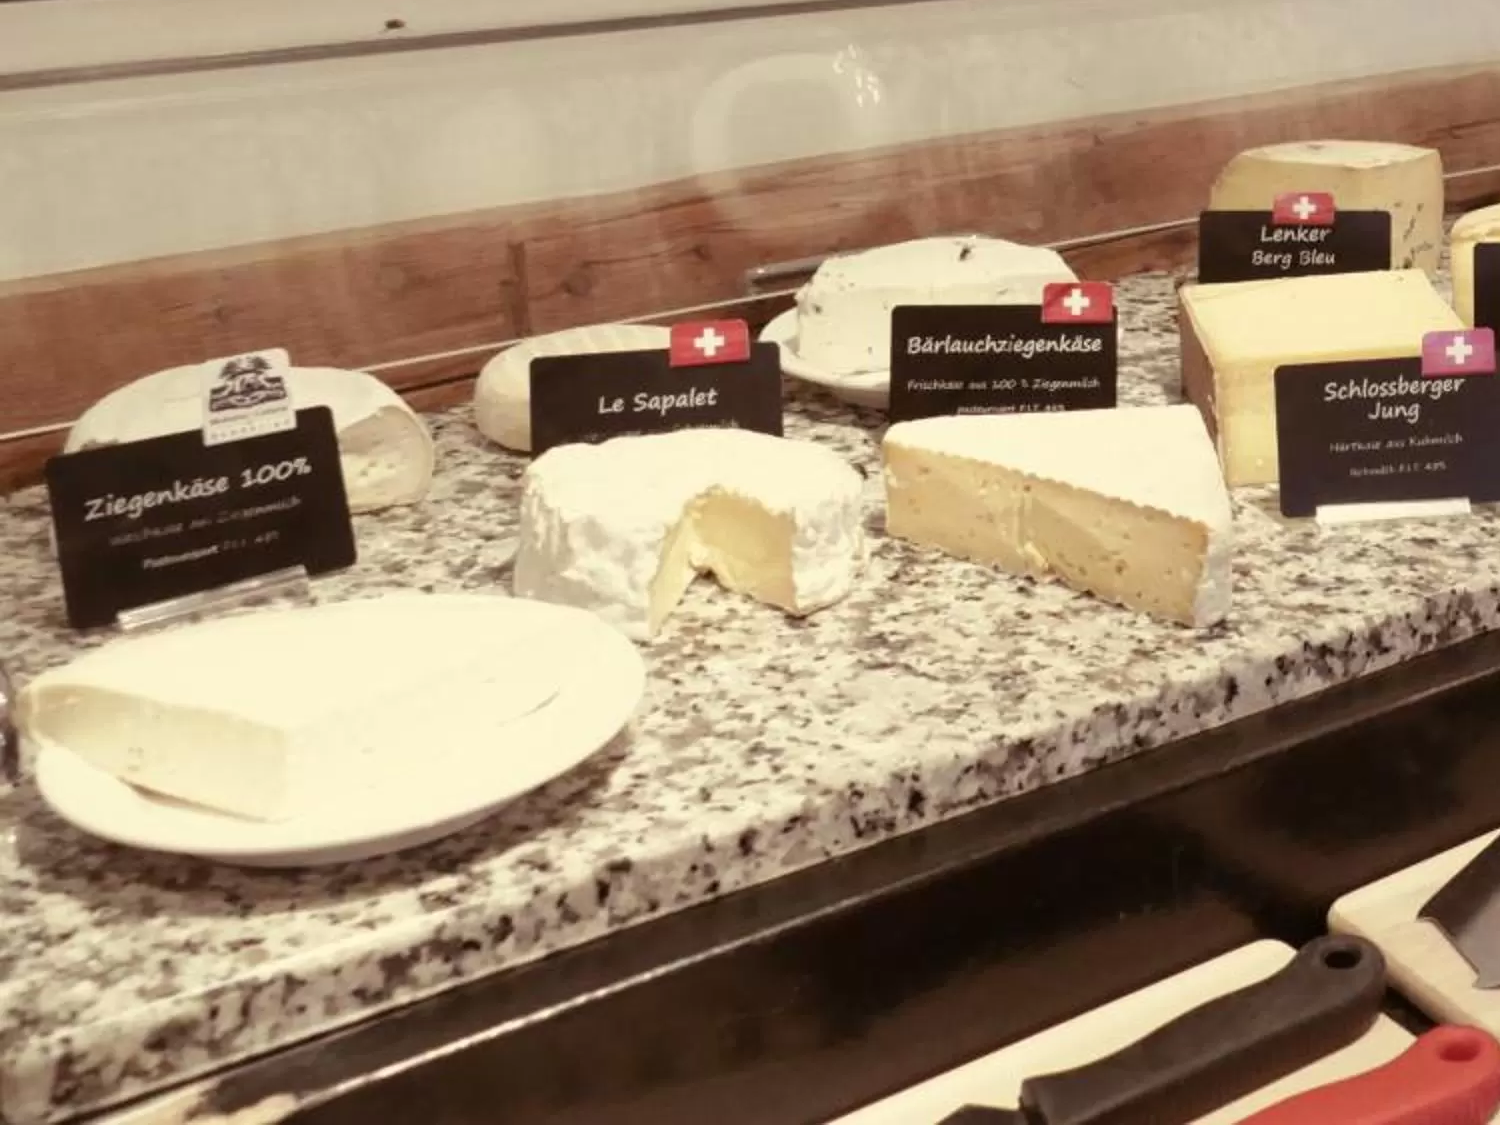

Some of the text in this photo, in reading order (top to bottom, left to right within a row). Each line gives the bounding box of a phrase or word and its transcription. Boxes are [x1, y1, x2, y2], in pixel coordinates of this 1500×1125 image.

[1260, 225, 1332, 243] Lenker
[1251, 247, 1336, 270] Berg Bleu
[907, 334, 1103, 359] Bärlauchziegenkäse
[597, 387, 719, 416] Le Sapalet
[1324, 376, 1465, 402] Schlossberger
[1368, 402, 1421, 424] Jung
[84, 476, 231, 522] Ziegenkäse
[240, 456, 313, 489] 100%
